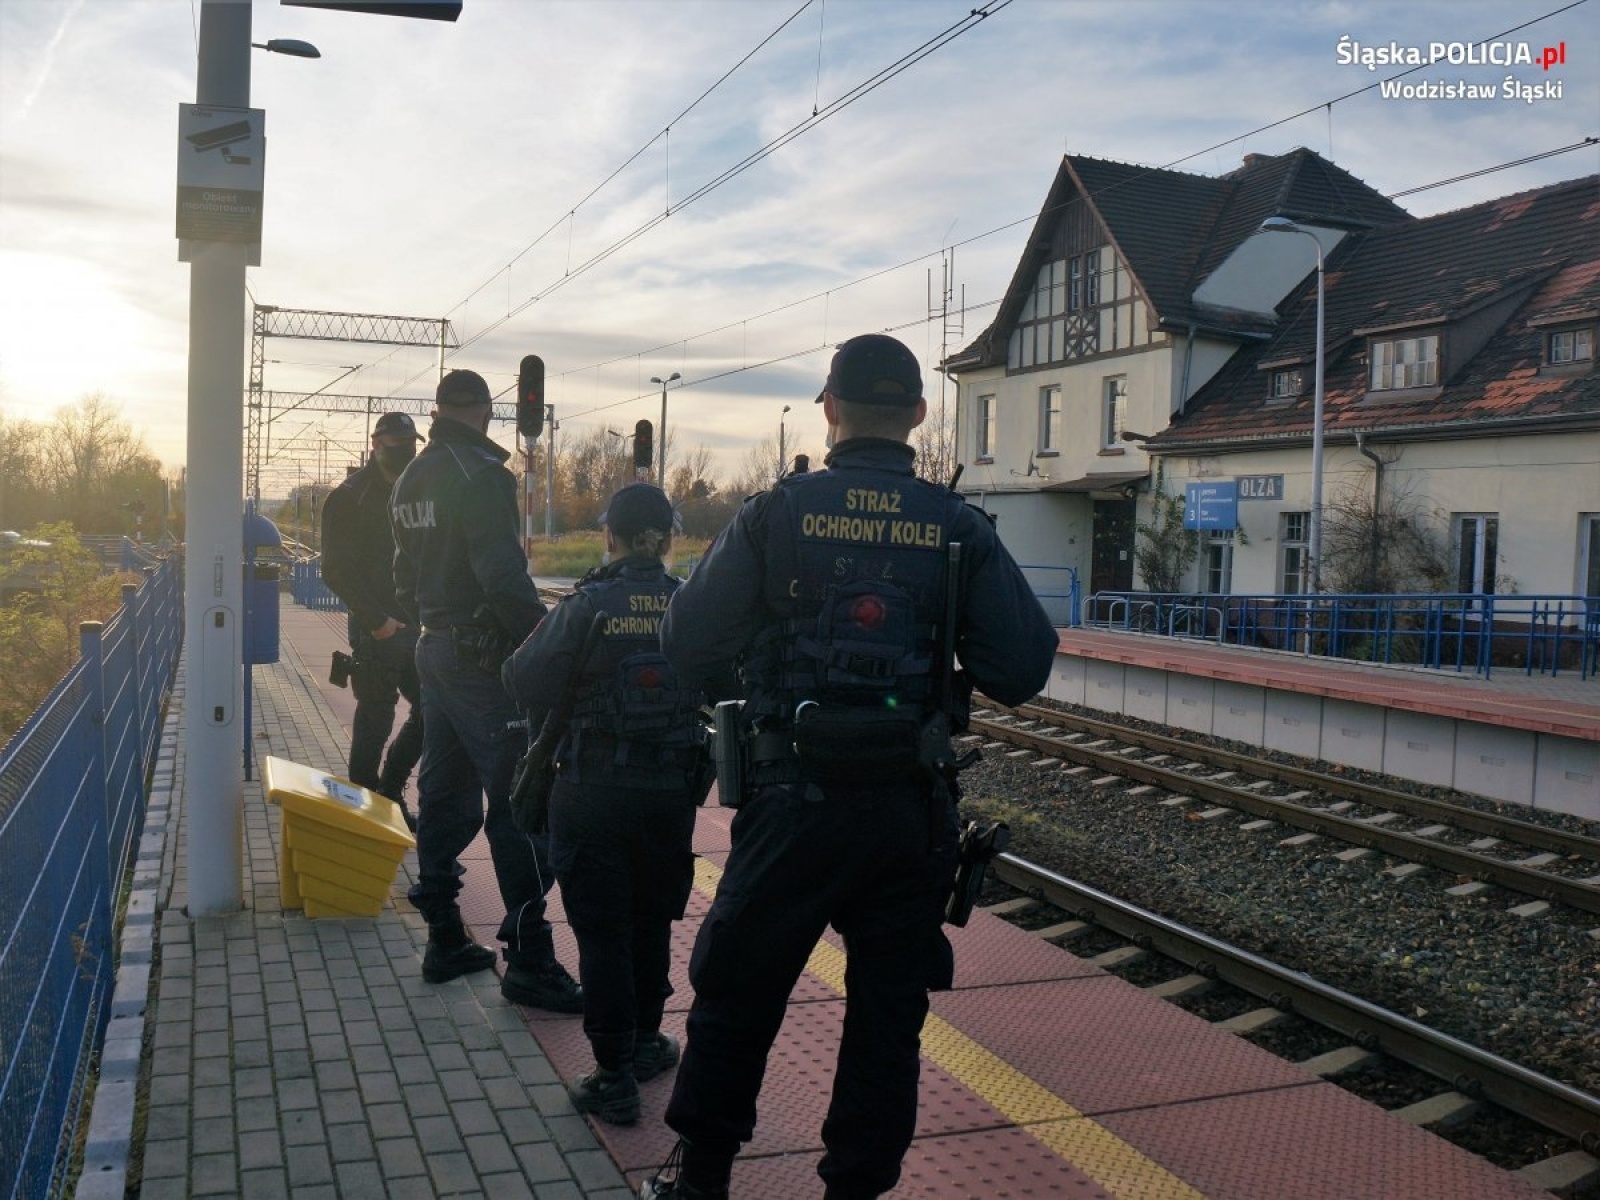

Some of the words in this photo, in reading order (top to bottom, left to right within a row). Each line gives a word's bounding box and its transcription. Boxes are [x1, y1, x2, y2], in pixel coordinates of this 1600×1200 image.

[1191, 490, 1196, 503] 1
[1240, 478, 1275, 496] OLZA
[846, 488, 902, 513] STRAŻ
[1189, 510, 1196, 521] 3
[802, 513, 887, 543] OCHRONY
[890, 520, 941, 547] KOLEI
[629, 592, 669, 613] STRAŻ
